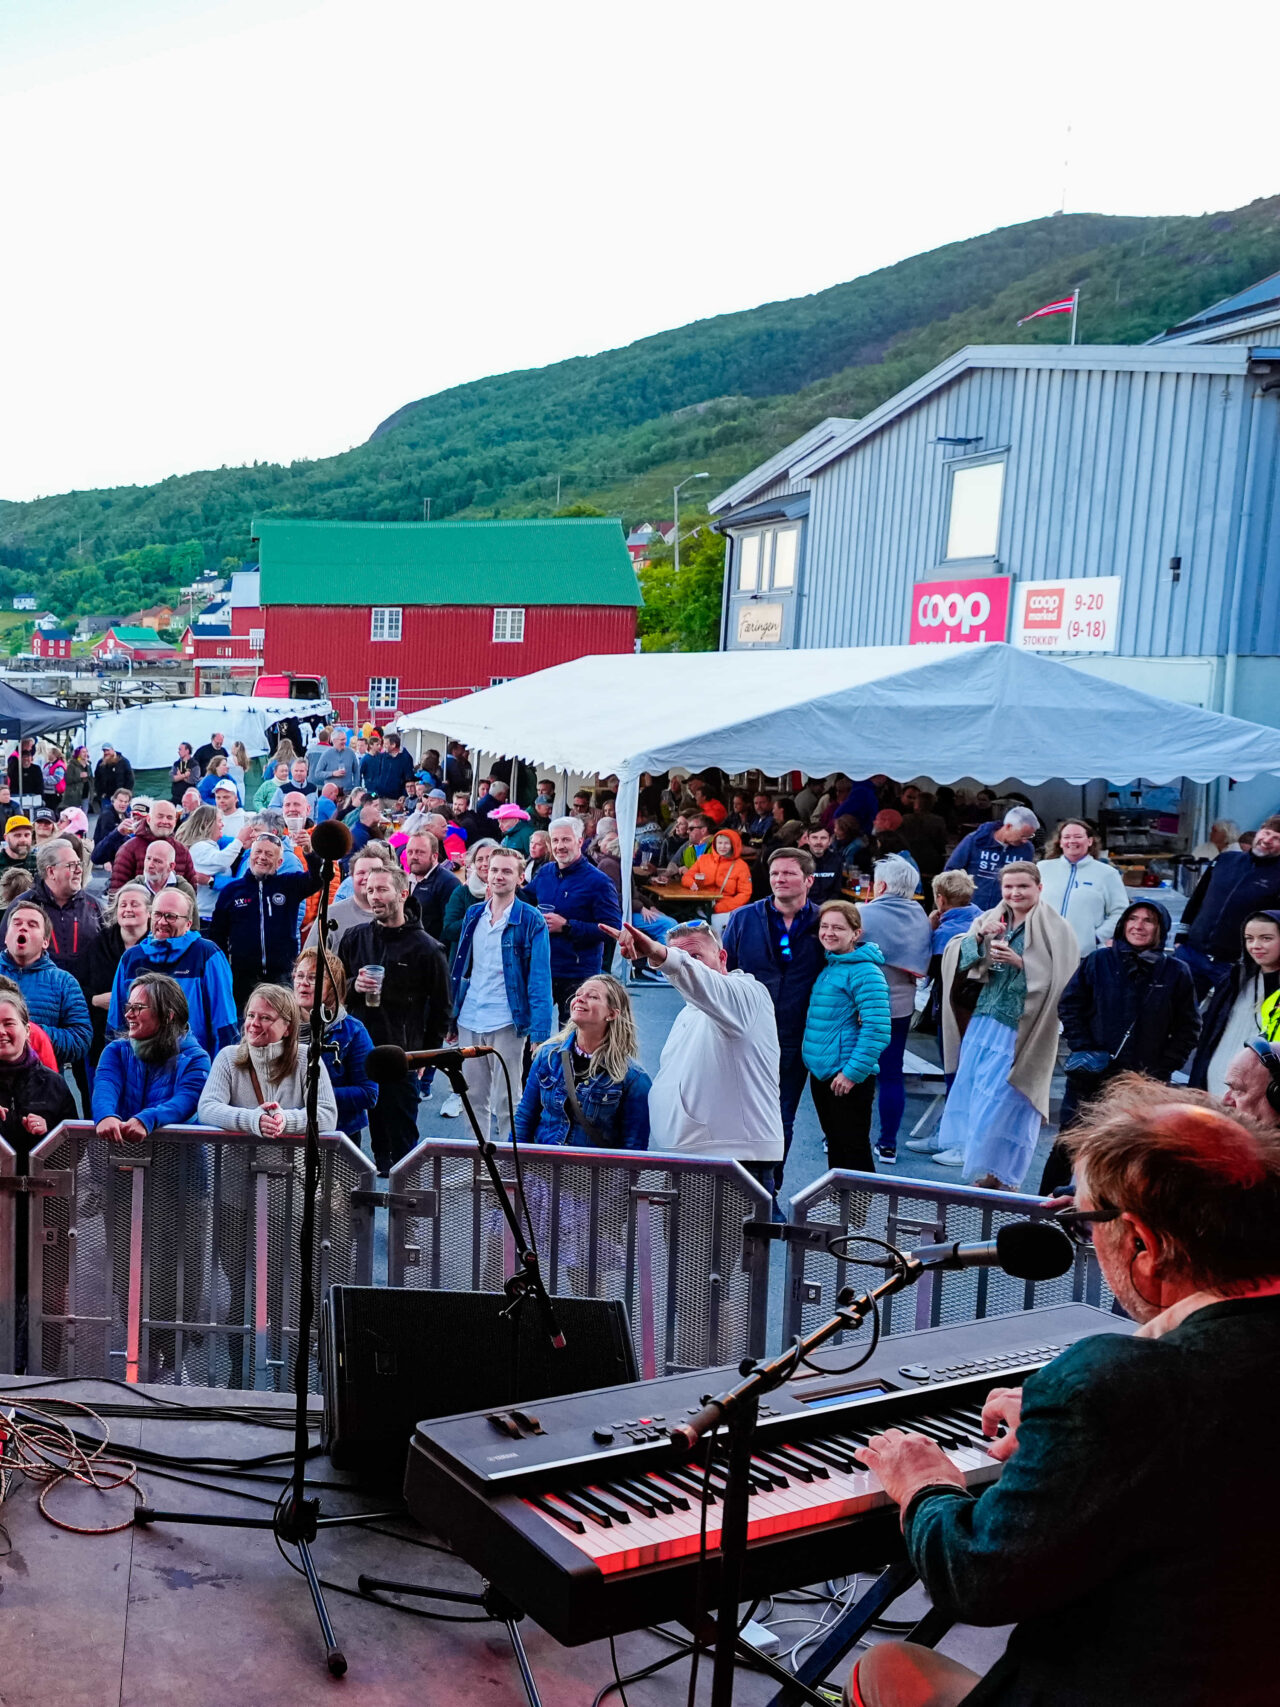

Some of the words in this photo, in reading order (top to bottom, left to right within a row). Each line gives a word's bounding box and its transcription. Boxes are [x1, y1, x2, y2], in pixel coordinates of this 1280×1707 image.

[1029, 595, 1060, 611] coop
[1075, 594, 1104, 610] 9-20
[918, 592, 991, 634] coop
[1067, 620, 1106, 640] (9-18)
